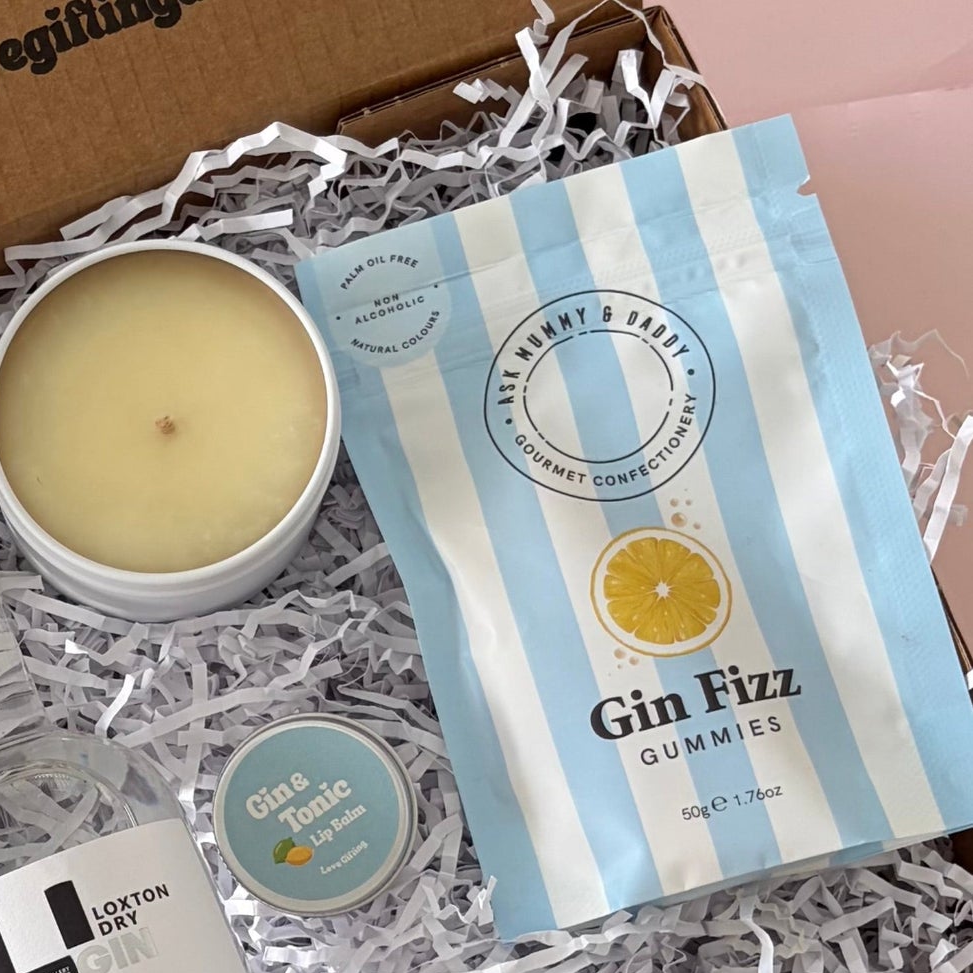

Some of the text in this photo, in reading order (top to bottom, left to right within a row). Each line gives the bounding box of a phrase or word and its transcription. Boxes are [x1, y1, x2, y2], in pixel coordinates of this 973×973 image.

[340, 254, 419, 290] PALM OIL FREE
[355, 295, 425, 325] ALCOHOLIC
[374, 293, 400, 307] NON
[350, 310, 440, 354] NATURAL COLOURS
[498, 305, 690, 406] ASK MUMMY & DADDY
[515, 393, 697, 487] GOURMET CONFECTIONERY
[590, 665, 802, 740] Gin Fizz
[640, 716, 782, 766] GUMMIES
[278, 779, 353, 834] Tonic
[733, 785, 783, 807] 1.76oz
[309, 804, 367, 848] Lip Balm
[91, 883, 170, 920] LOXTON
[97, 911, 139, 937] DRY
